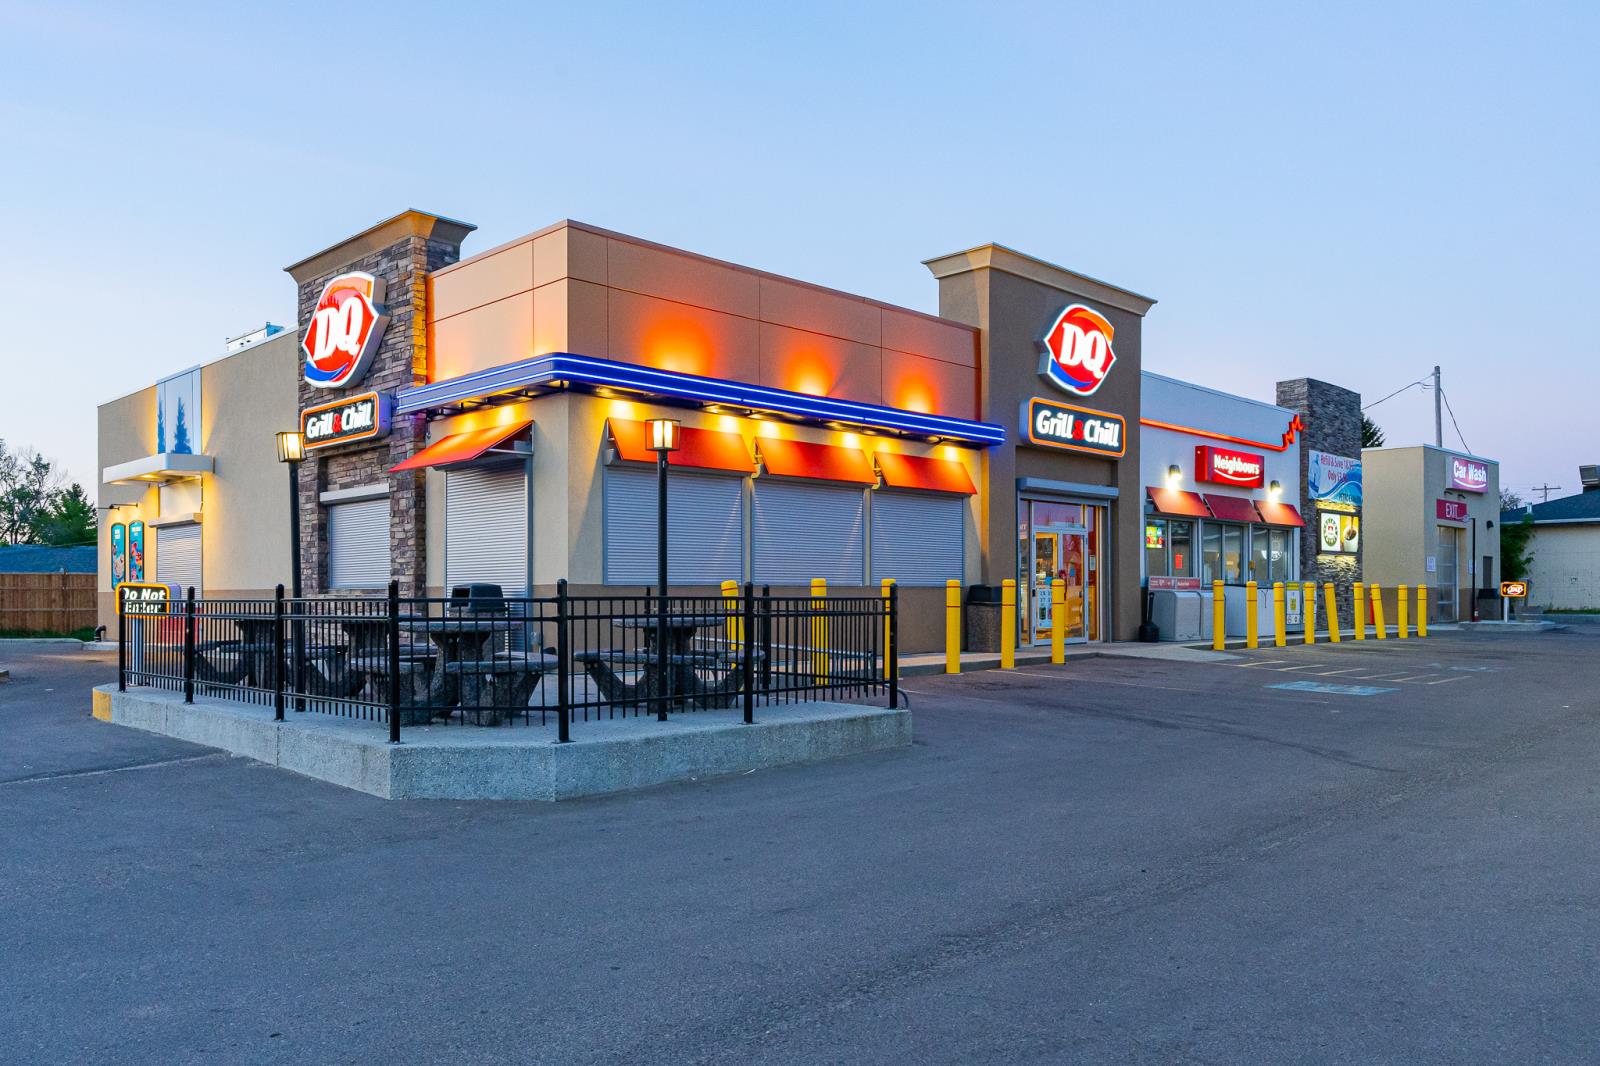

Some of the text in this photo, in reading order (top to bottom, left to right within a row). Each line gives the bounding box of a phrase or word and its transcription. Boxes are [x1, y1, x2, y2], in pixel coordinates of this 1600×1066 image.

[314, 297, 363, 360] DQ
[1059, 322, 1107, 379] DQ
[1213, 454, 1260, 475] Neighbours
[1453, 460, 1487, 482] Car Wash
[1445, 502, 1458, 519] EXIT
[141, 588, 166, 600] Not
[125, 601, 161, 613] Enter
